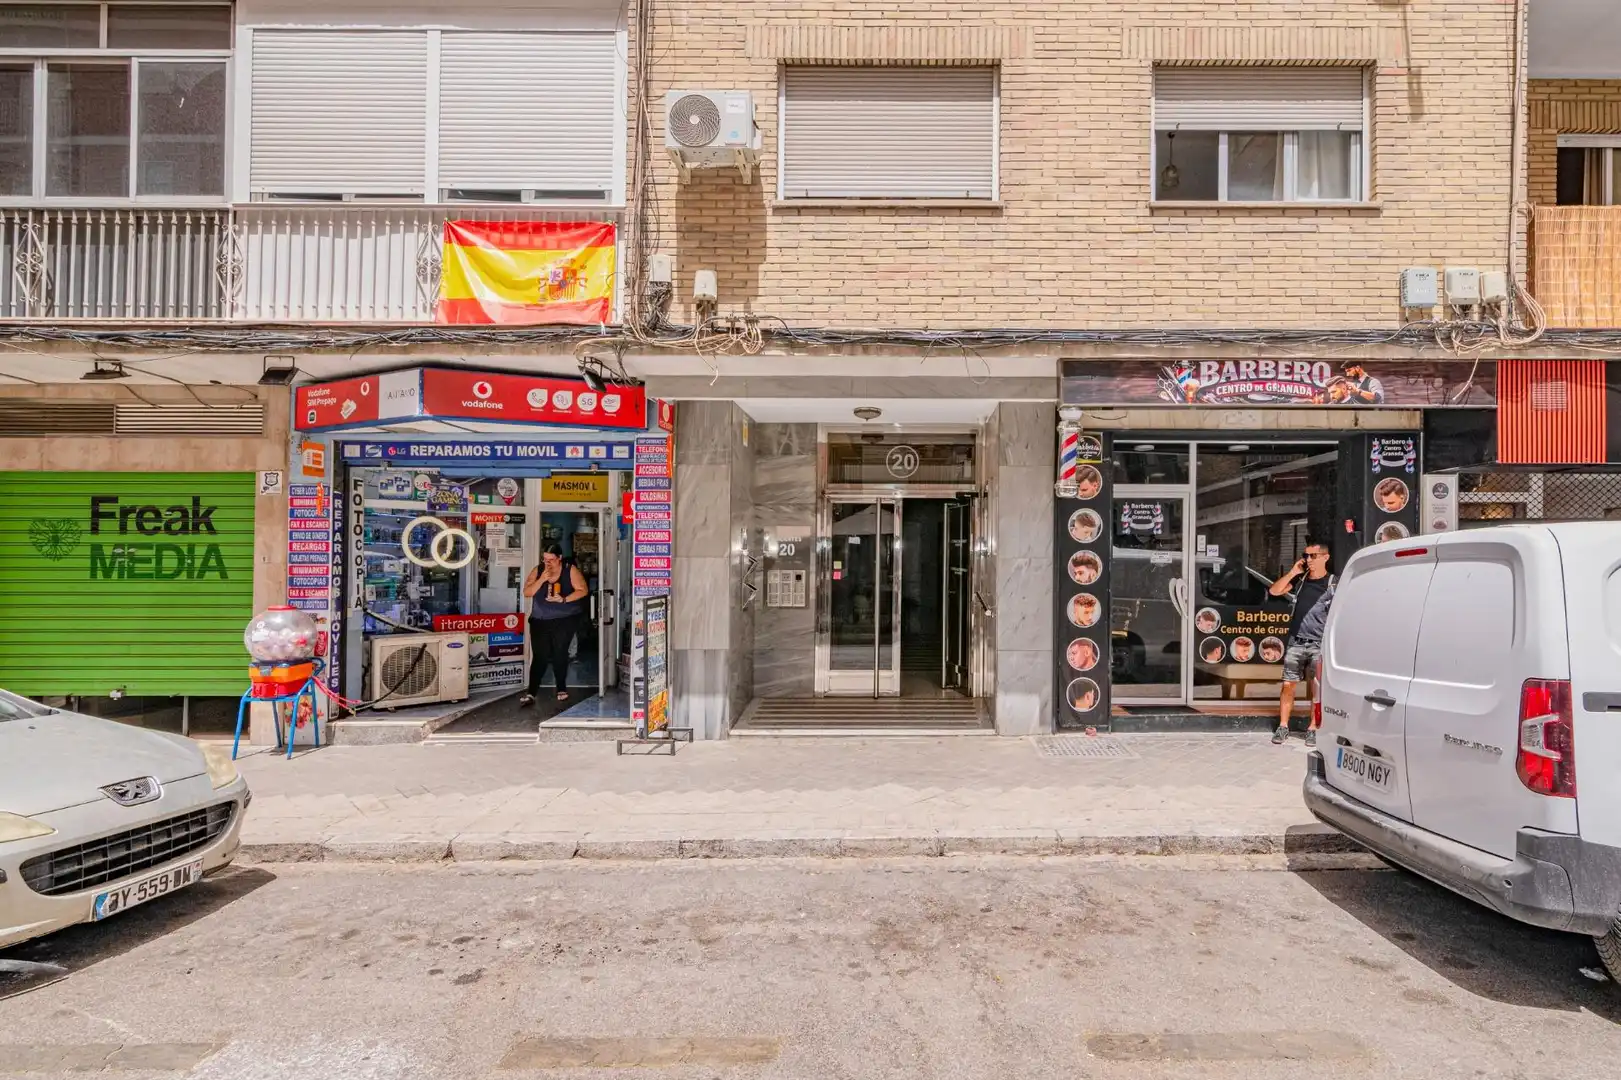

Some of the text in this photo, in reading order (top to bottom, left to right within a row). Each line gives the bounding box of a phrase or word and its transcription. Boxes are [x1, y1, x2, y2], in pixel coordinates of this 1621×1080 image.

[1200, 361, 1331, 388] BARBERO
[308, 388, 330, 397] Vodafone
[1216, 383, 1252, 395] CENTRO
[1266, 383, 1312, 395] GRANADA
[317, 397, 337, 407] Prepago
[462, 400, 503, 410] vodafone
[582, 397, 592, 406] 5G
[410, 445, 558, 457] REPARAMOS TU MOVIL
[892, 454, 914, 470] 20
[639, 466, 667, 474] ACCESORIO
[553, 482, 598, 491] MASMOVL
[90, 496, 218, 536] Freak
[333, 499, 342, 599] REPARAMOS
[353, 479, 364, 608] FOTOCOPIA
[778, 543, 795, 556] 20
[89, 543, 229, 580] MEDIA
[640, 558, 667, 568] GOLOSINAS
[293, 567, 327, 575] MINIMARKET
[290, 588, 299, 596] FAX
[1236, 611, 1290, 622] Barbero
[1220, 626, 1252, 634] Centro
[1254, 625, 1266, 634] de
[331, 611, 341, 688] MOVILES
[468, 668, 522, 682] ycamobile
[1342, 752, 1390, 786] 8900 NGY
